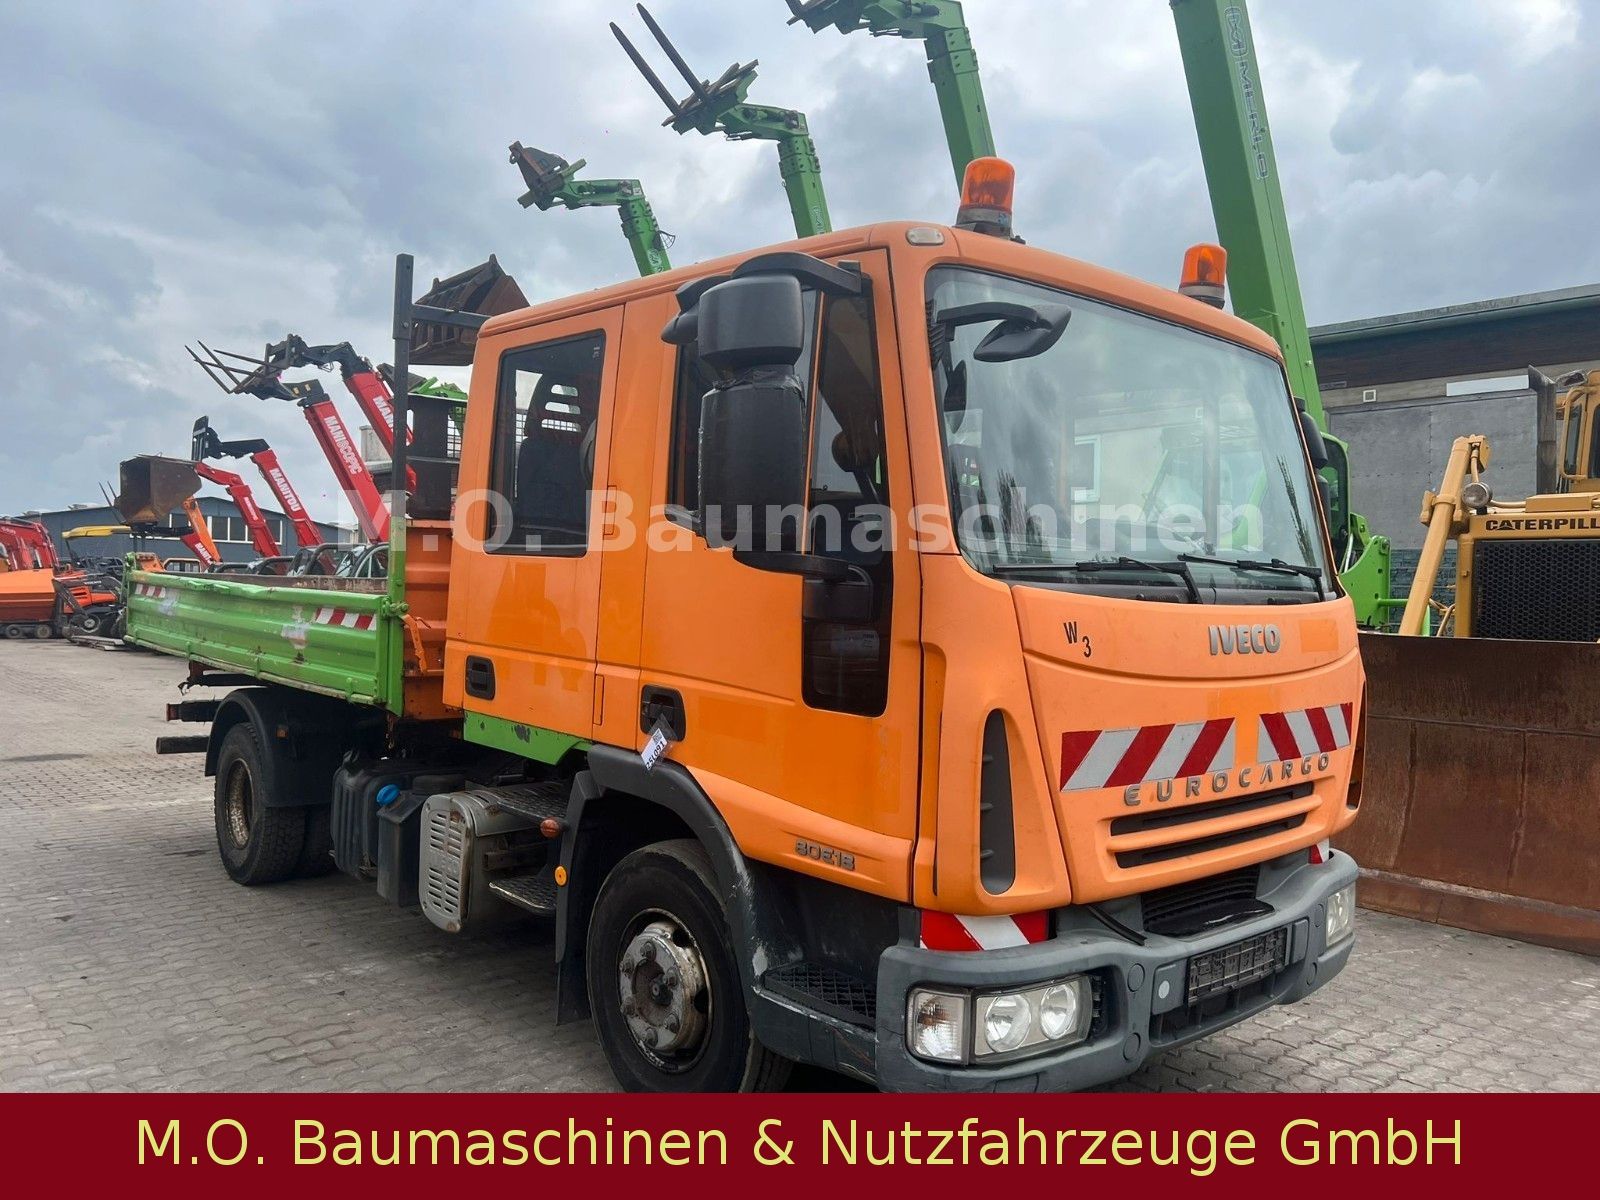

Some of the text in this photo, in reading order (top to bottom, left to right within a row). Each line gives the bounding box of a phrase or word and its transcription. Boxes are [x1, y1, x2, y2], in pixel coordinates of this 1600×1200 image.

[269, 467, 302, 512] MANITOU
[1208, 623, 1281, 656] IVECO
[1124, 752, 1330, 806] EUROCARGO
[796, 838, 856, 871] 80E18
